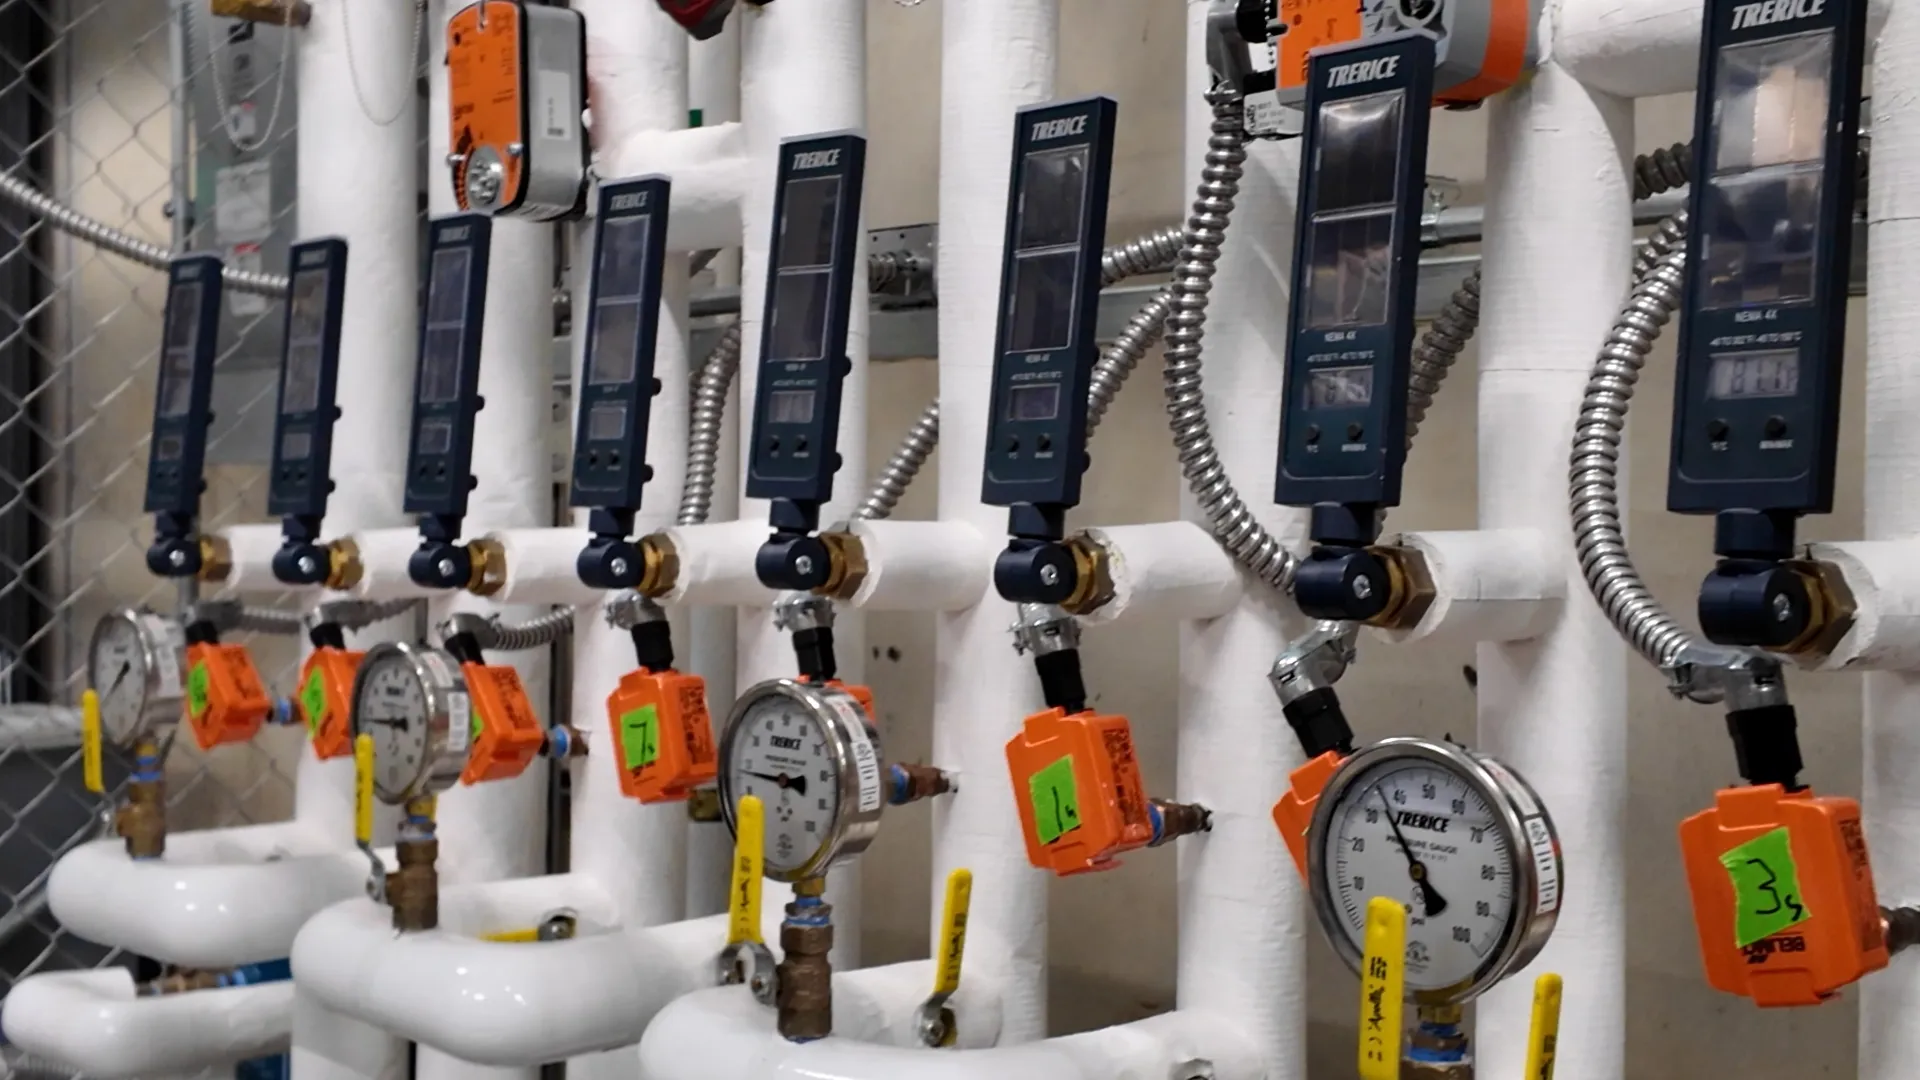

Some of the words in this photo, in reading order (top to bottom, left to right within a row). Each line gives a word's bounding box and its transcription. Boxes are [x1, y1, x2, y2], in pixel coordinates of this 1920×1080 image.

[1731, 0, 1825, 30] TRERICE
[1327, 55, 1400, 89] TRERICE
[1031, 114, 1088, 142] TRERICE
[1422, 783, 1437, 800] 50
[1470, 826, 1485, 844] 70
[1352, 836, 1366, 853] 20
[1481, 864, 1497, 881] 80
[1452, 925, 1471, 943] 100
